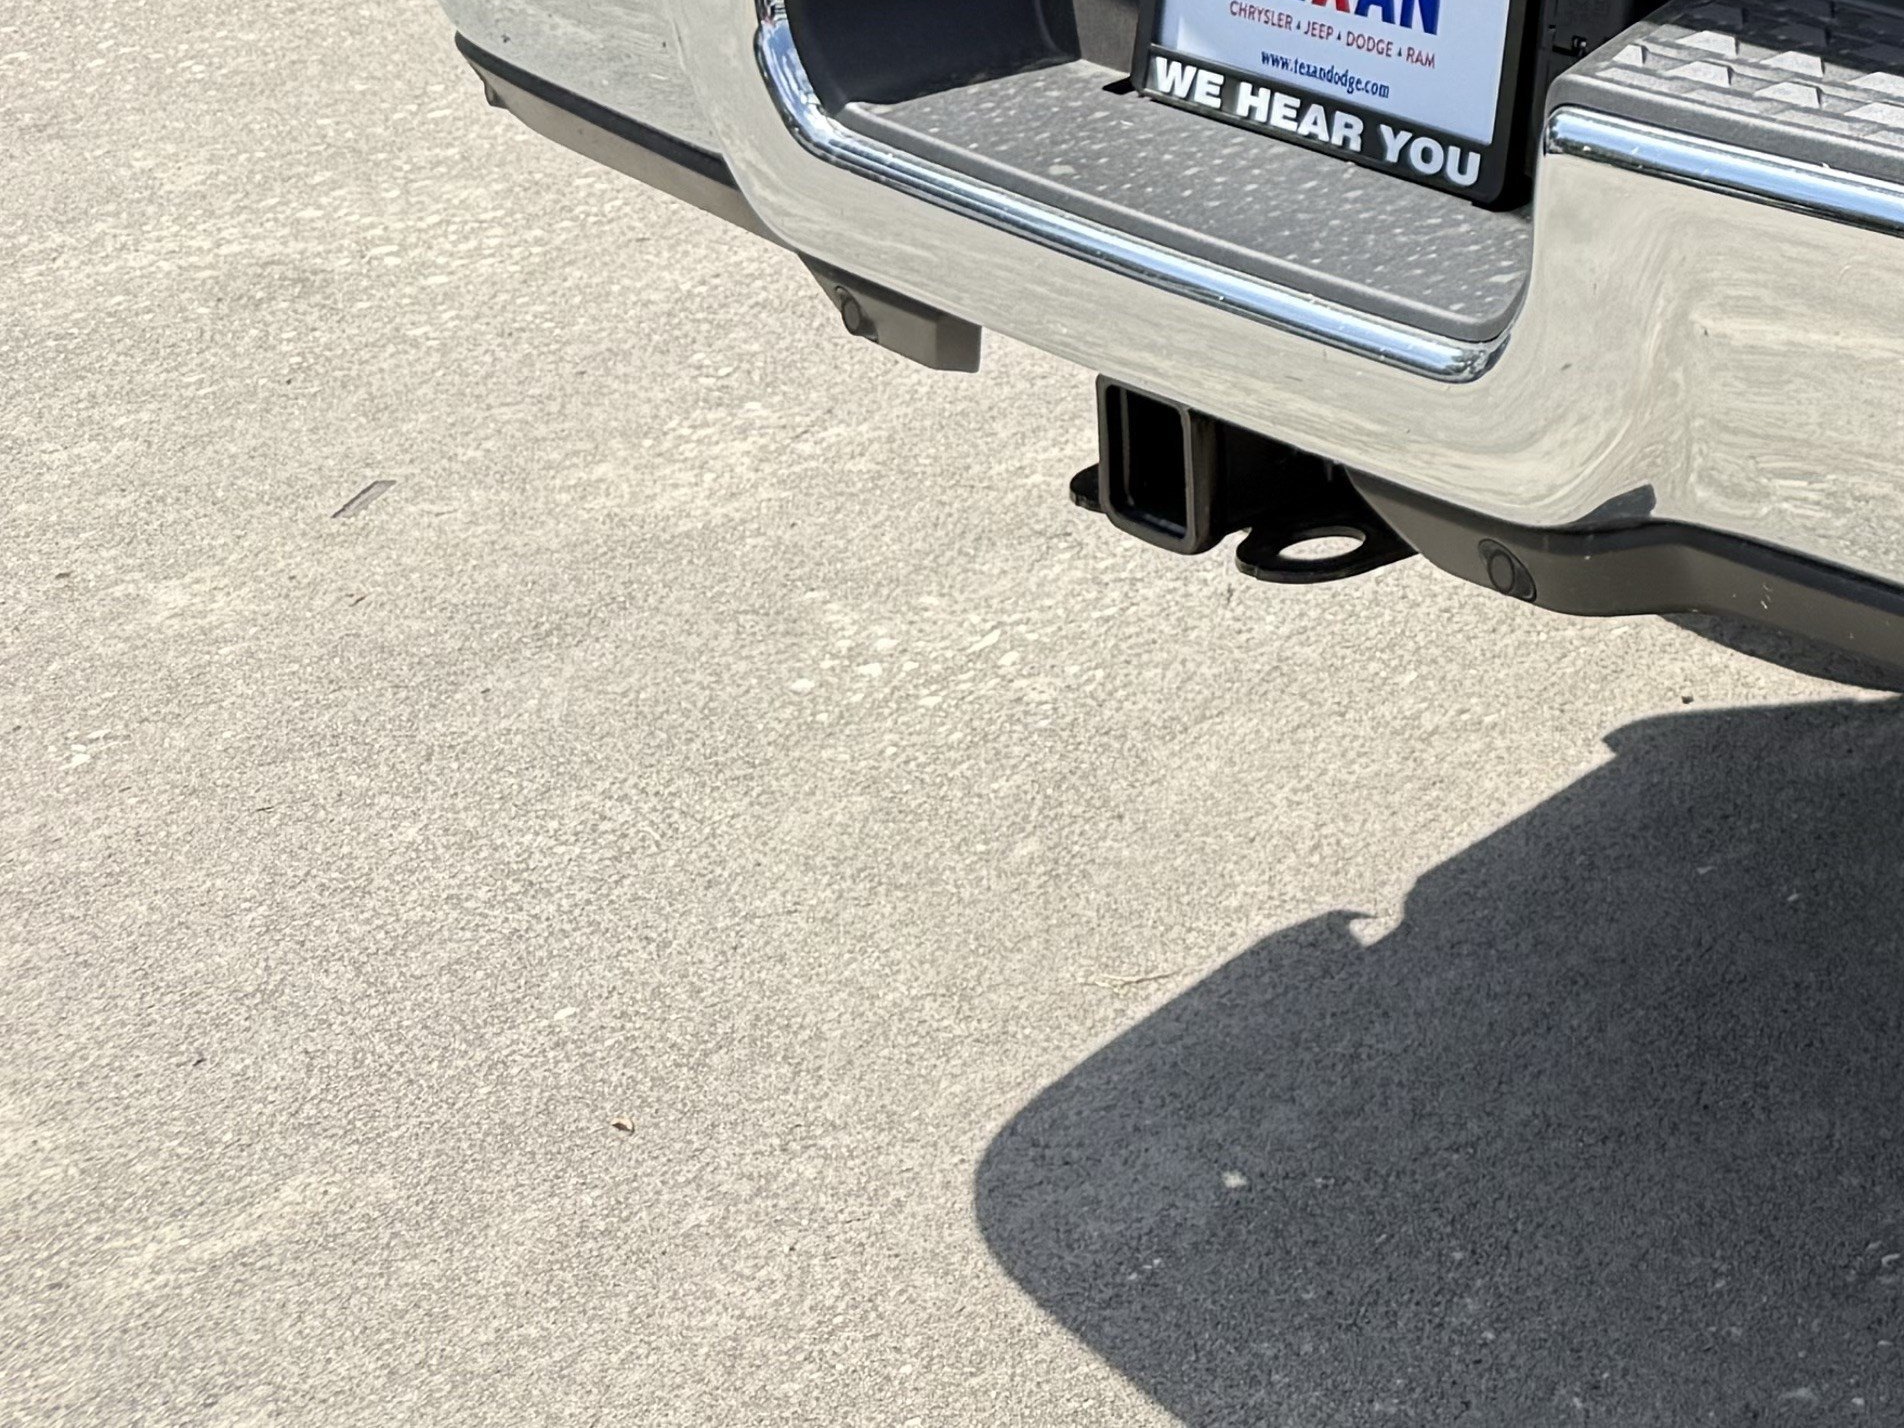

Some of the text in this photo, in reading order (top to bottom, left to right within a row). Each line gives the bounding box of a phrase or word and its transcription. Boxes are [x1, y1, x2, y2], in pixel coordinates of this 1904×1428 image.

[1229, 0, 1436, 70] CHRYSLER JEEP DODGE RAM
[1260, 49, 1391, 100] www.texandodge.com
[1152, 55, 1482, 188] WE HEAR YOU
